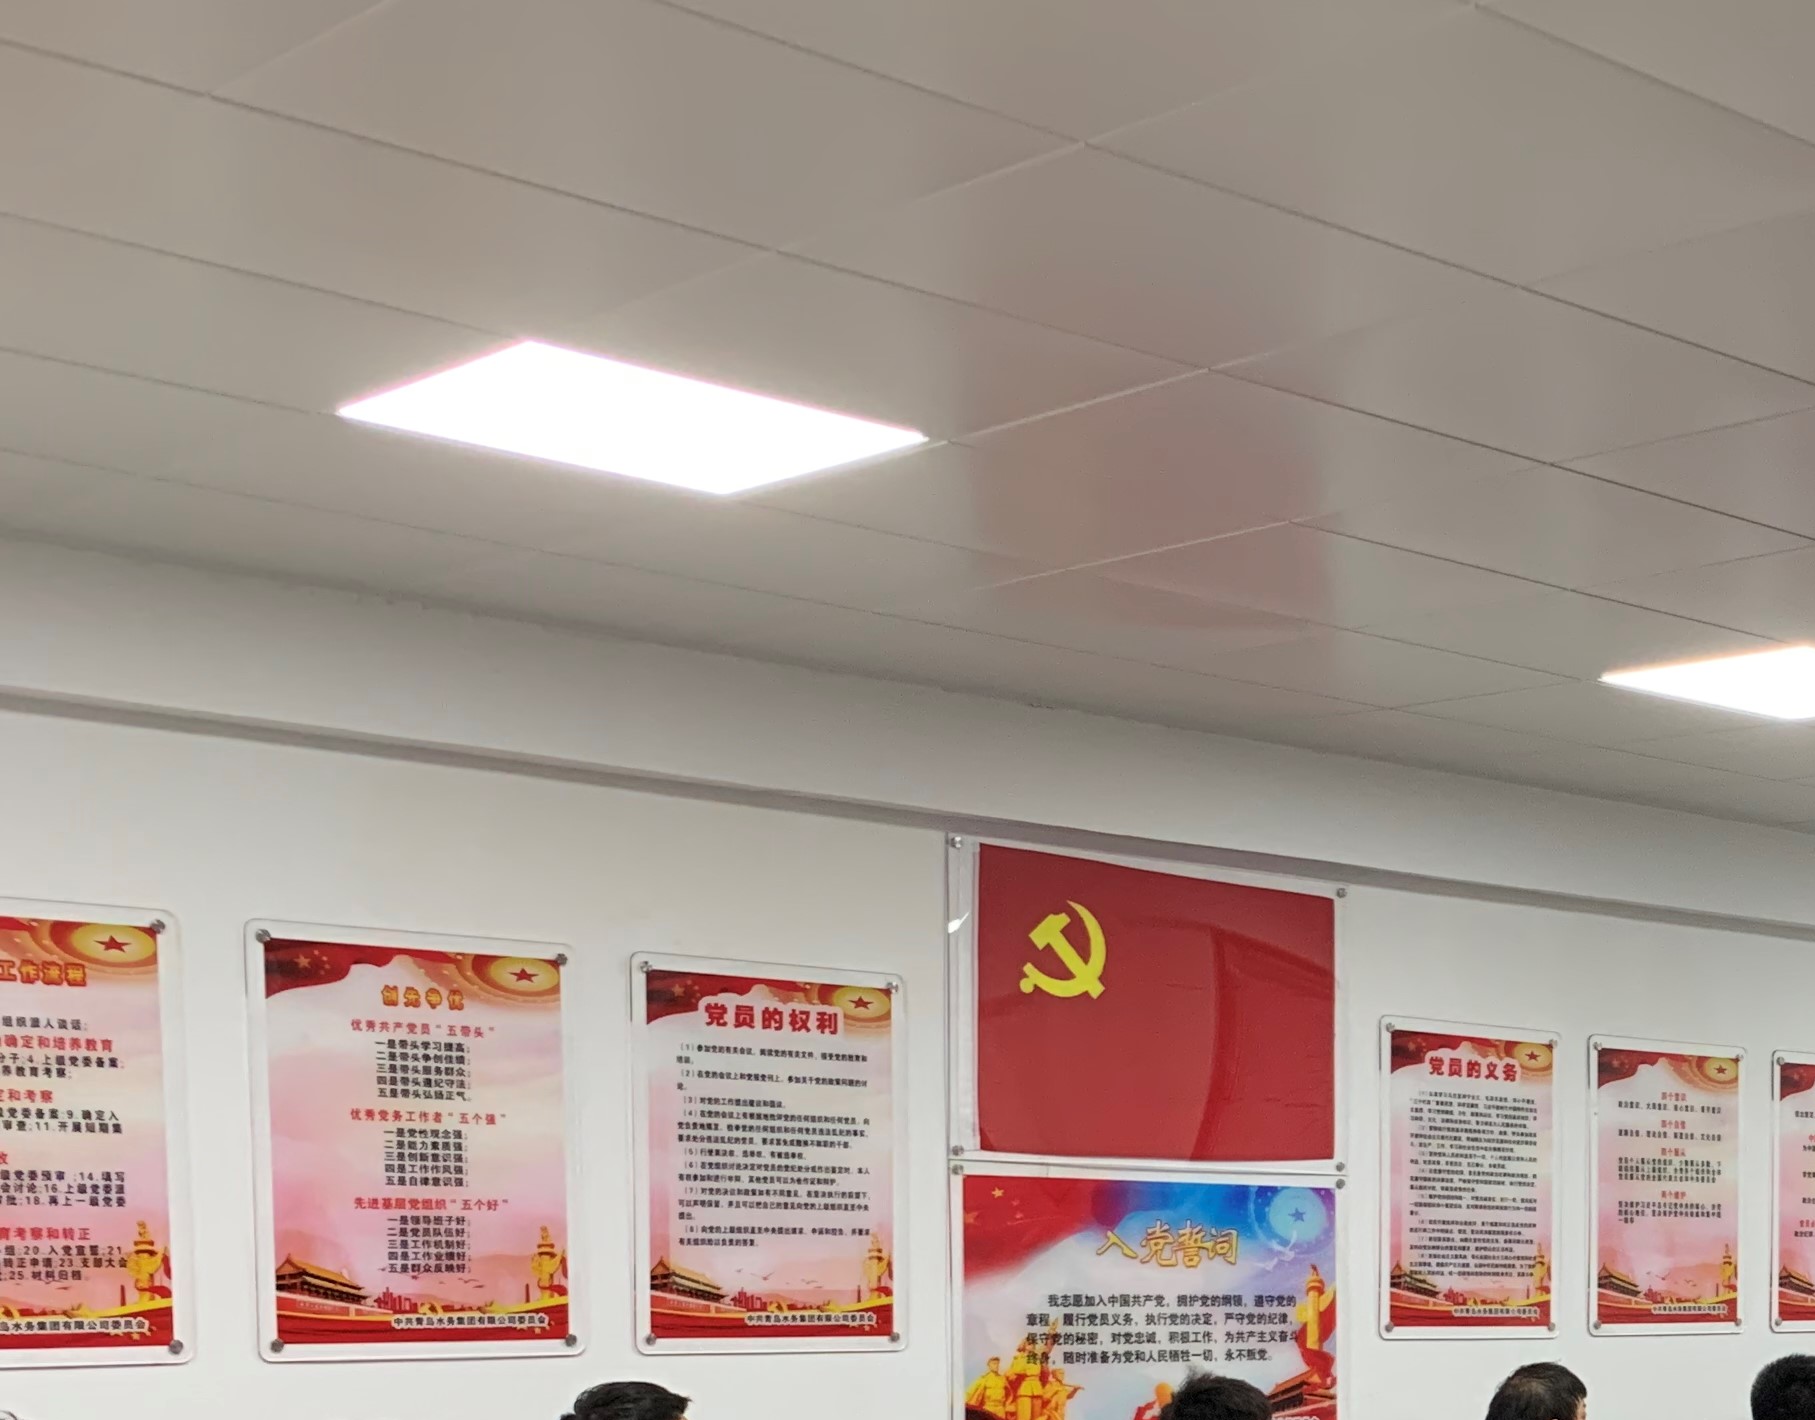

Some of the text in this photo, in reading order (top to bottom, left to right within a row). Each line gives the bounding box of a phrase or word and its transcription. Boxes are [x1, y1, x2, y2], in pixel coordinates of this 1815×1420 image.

[704, 1002, 839, 1035] 党员的权利
[0, 1034, 113, 1053] 确定和培养教育
[1428, 1055, 1518, 1082] 党员的义务
[1096, 1218, 1238, 1268] 入党誓词
